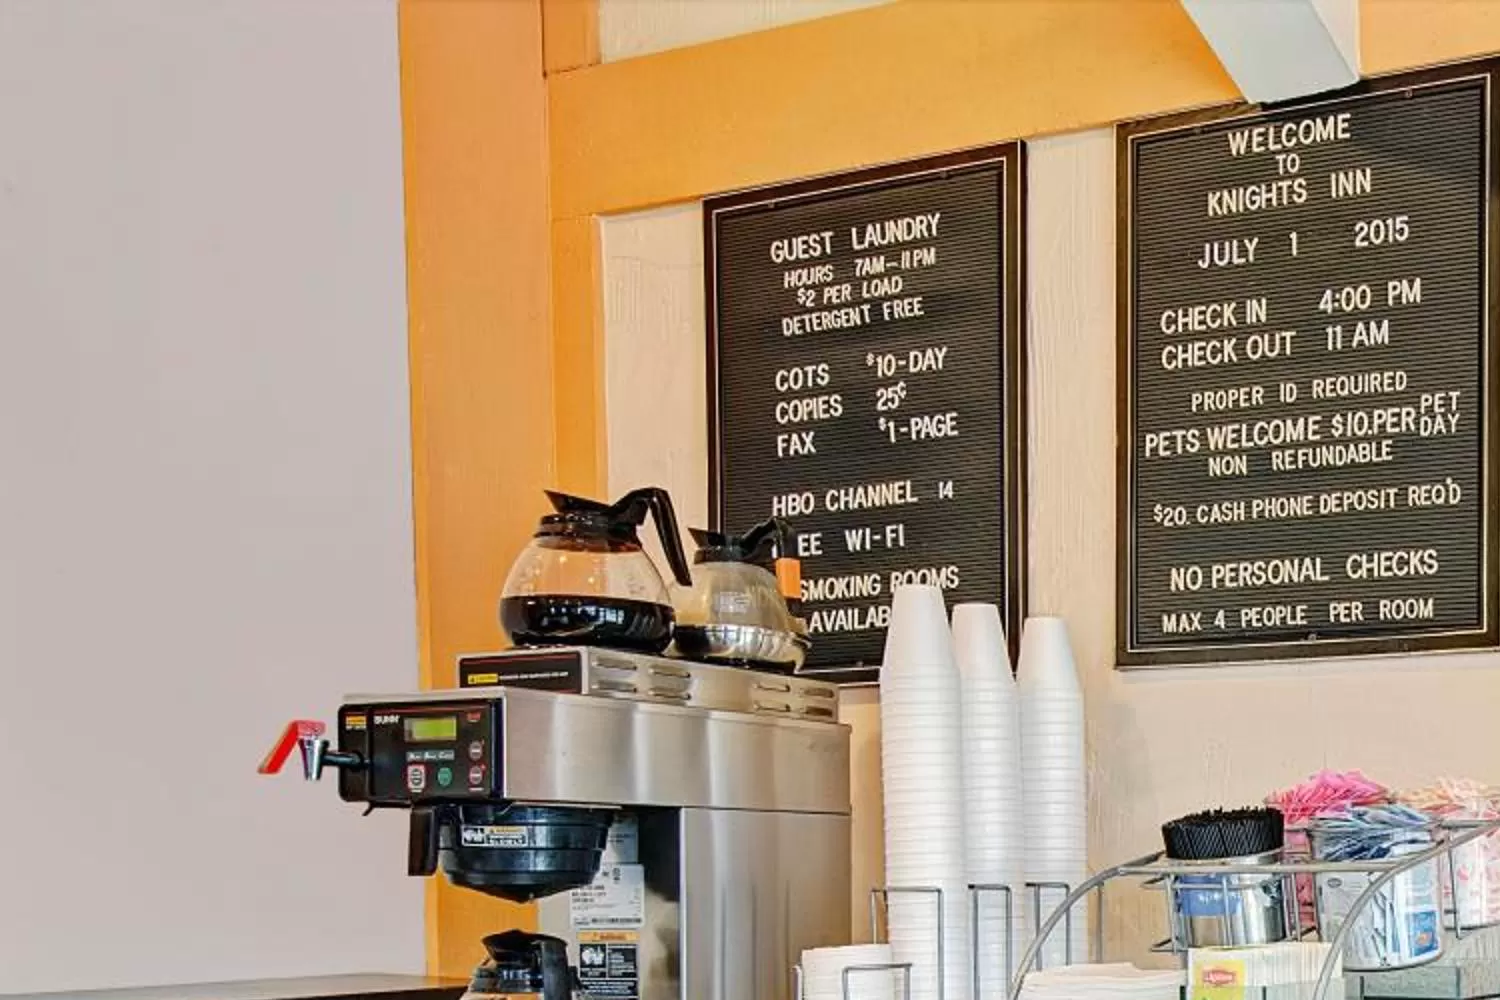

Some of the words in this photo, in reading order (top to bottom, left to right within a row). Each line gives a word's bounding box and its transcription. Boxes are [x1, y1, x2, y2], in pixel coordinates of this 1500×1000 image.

[1228, 114, 1351, 156] WELCOME
[1276, 154, 1300, 175] TO
[1207, 177, 1308, 217] KNIGHTS
[1330, 168, 1371, 198] INN
[771, 232, 834, 263] GUEST
[851, 213, 940, 250] LAUNDRY
[1198, 237, 1259, 268] JULY
[1289, 231, 1298, 256] 1
[1354, 216, 1409, 247] 2015
[784, 265, 833, 288] HOURS
[798, 288, 814, 307] $2
[824, 283, 850, 305] PER
[862, 276, 902, 298] LOAD
[782, 304, 871, 336] DETERGENT
[883, 298, 924, 321] FREE
[1160, 302, 1237, 334] CHECK
[1246, 298, 1267, 324] IN
[1318, 286, 1370, 313] 4:00
[1387, 278, 1422, 306] PM
[1161, 337, 1238, 370] CHECK
[1246, 331, 1296, 360] OUT
[1325, 326, 1342, 350] 11
[1352, 320, 1389, 348] AM
[775, 364, 830, 391] COTS
[1191, 386, 1263, 412] PROPER
[1280, 383, 1297, 403] ID
[1312, 371, 1407, 400] REQUIRED
[775, 395, 843, 424] COPIES
[1420, 391, 1460, 414] PET
[1145, 429, 1201, 458] PETS
[1207, 416, 1322, 451] WELCOME
[1420, 414, 1460, 437] DAY
[777, 431, 816, 457] FAX
[1208, 455, 1247, 476] NON
[1272, 440, 1393, 471] REFUNDABLE
[772, 493, 814, 517] HBO
[825, 480, 918, 511] CHANNEL
[939, 481, 953, 499] 14
[1197, 501, 1245, 524] CASH
[1252, 495, 1313, 520] PHONE
[1319, 488, 1398, 515] DEPOSIT
[845, 524, 904, 552] WI-FI
[799, 574, 881, 602] SMOKING
[1170, 564, 1202, 592] NO
[1212, 557, 1329, 588] PERSONAL
[1346, 550, 1438, 580] CHECKS
[809, 605, 891, 633] AVAILAB
[1162, 611, 1201, 634] MAX
[1214, 609, 1225, 629] 4
[1241, 605, 1308, 628] PEOPLE
[1329, 602, 1363, 623] PER
[1379, 598, 1434, 621] ROOM
